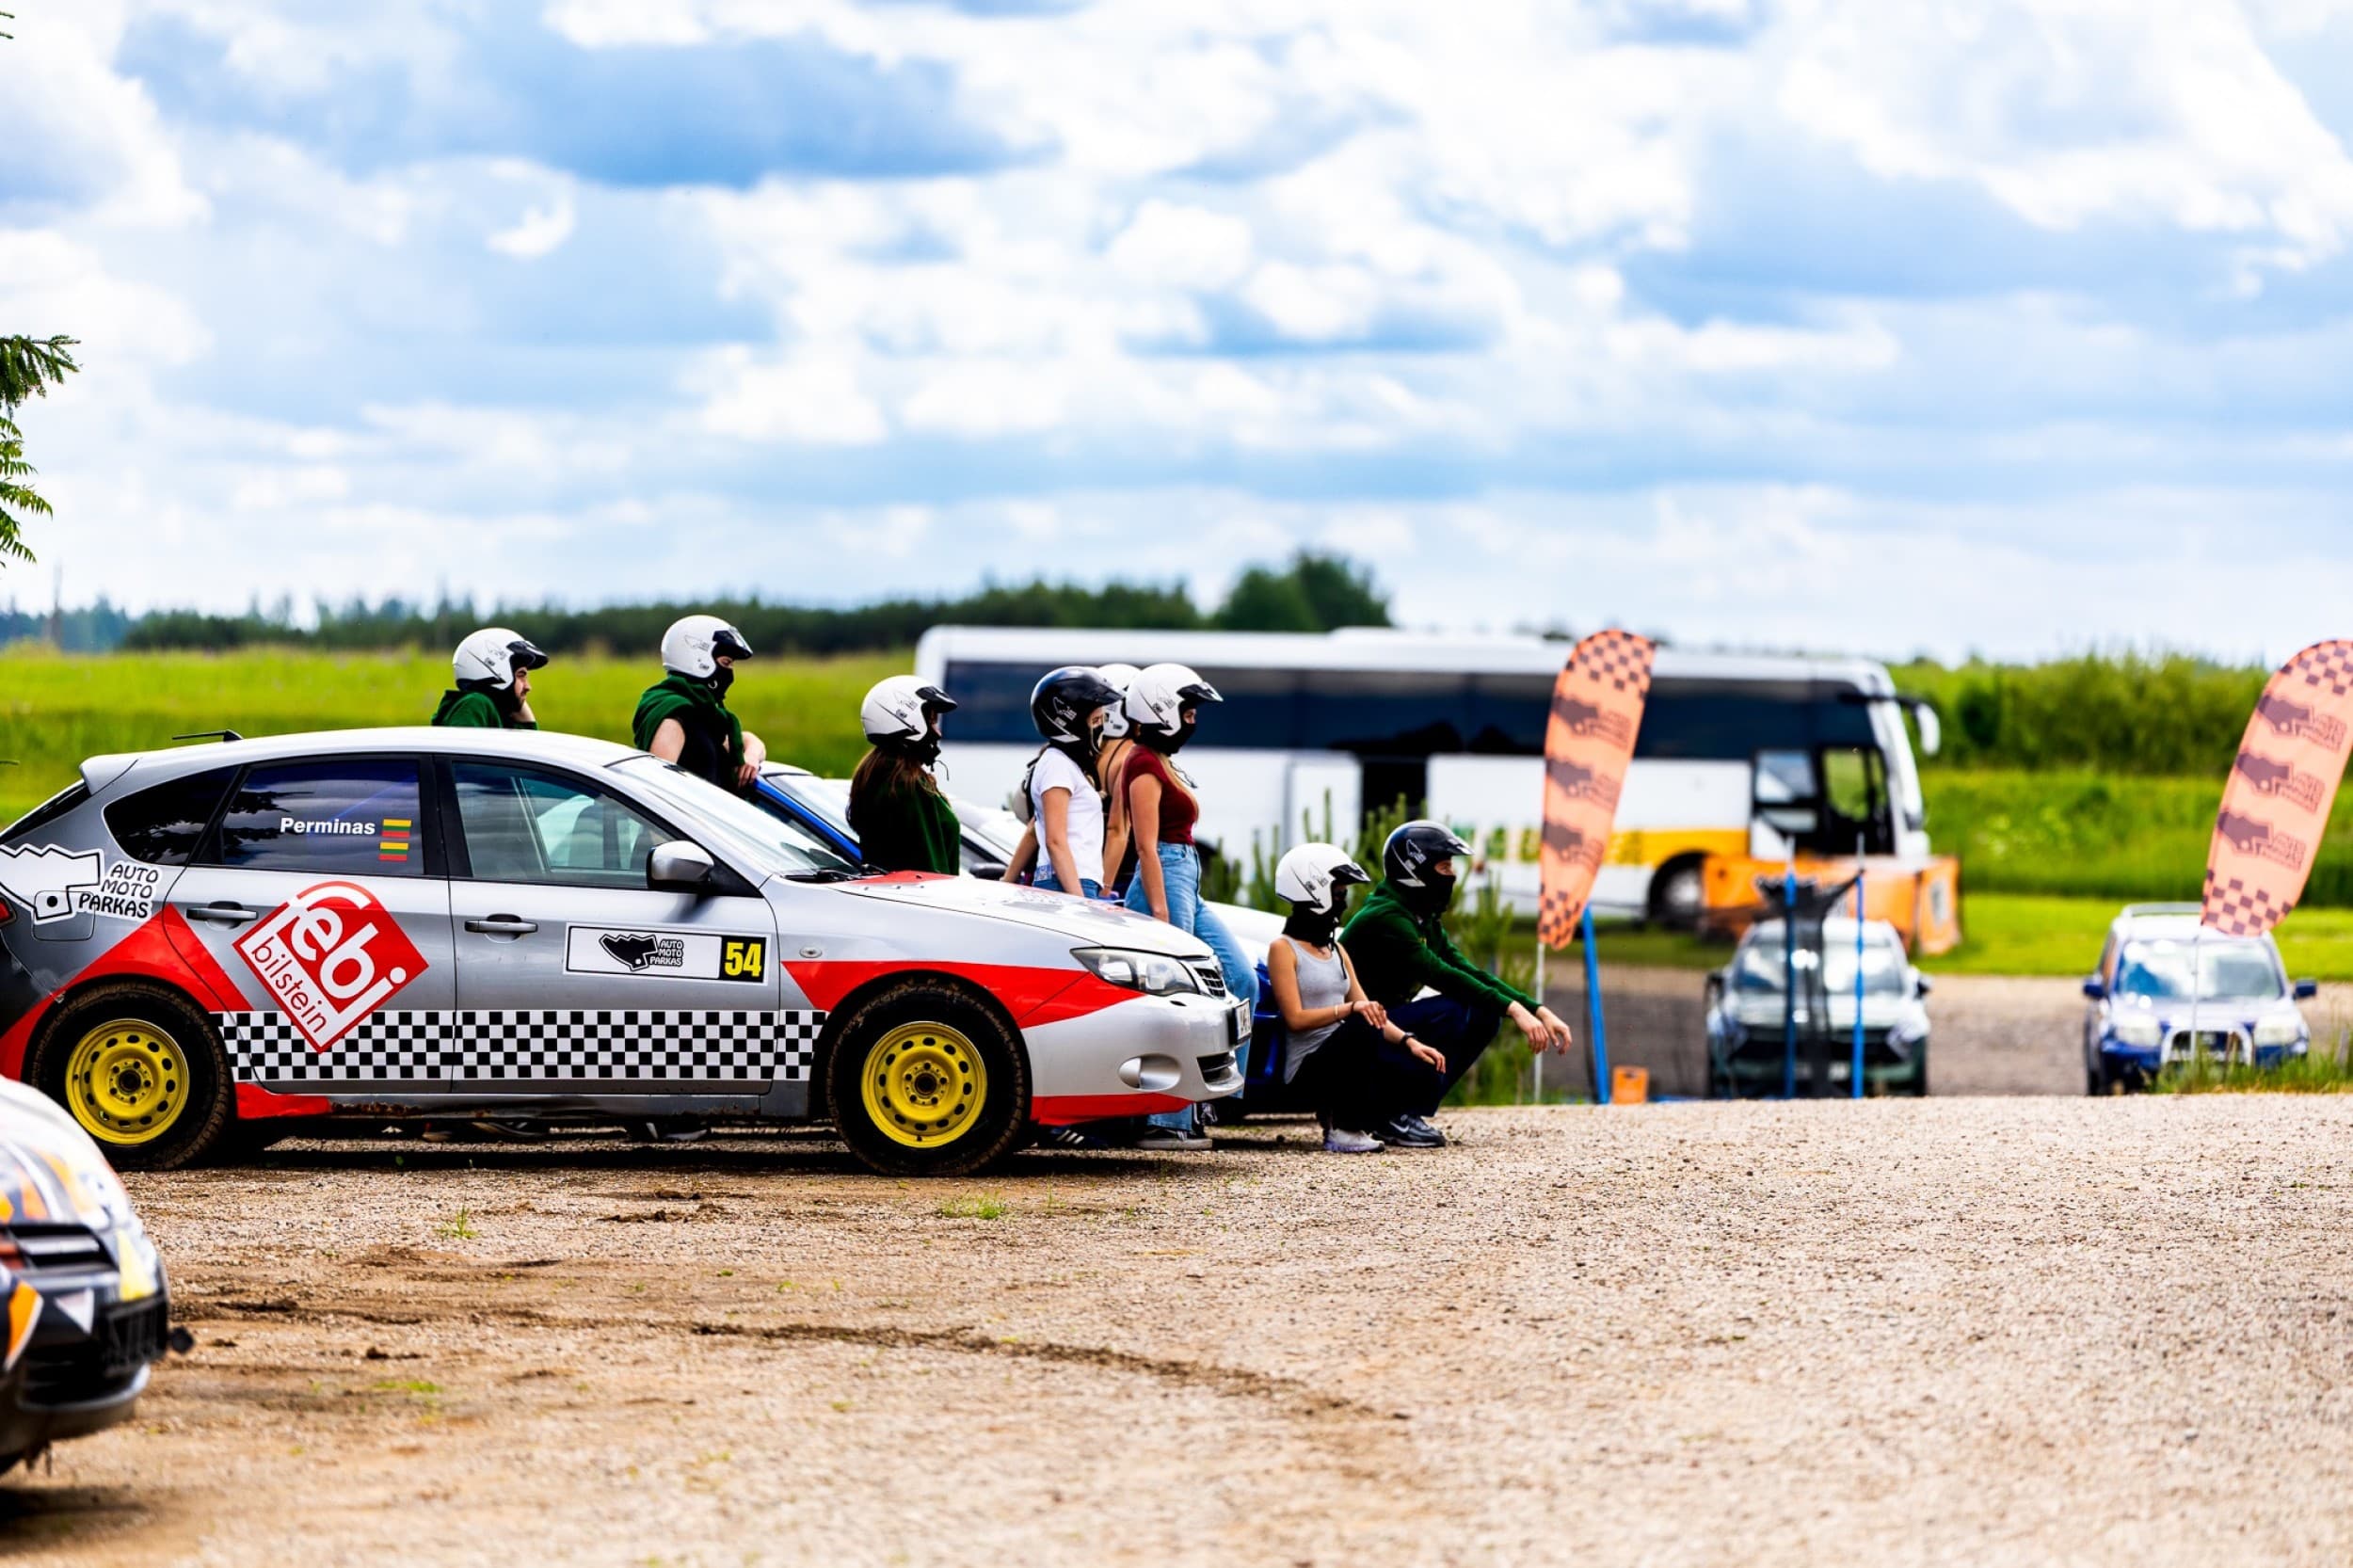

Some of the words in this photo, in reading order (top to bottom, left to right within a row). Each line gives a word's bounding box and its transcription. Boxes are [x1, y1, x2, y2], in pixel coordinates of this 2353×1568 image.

[280, 817, 376, 835] Perminas
[110, 864, 159, 883] AUTO
[101, 879, 152, 899] MOTO
[78, 892, 149, 919] PARKAS
[658, 948, 682, 957] MOTO
[660, 940, 683, 949] AUTO
[240, 886, 407, 1047] febi
[649, 956, 682, 966] PARKAS
[724, 941, 761, 977] 54
[251, 936, 327, 1033] bilstein
